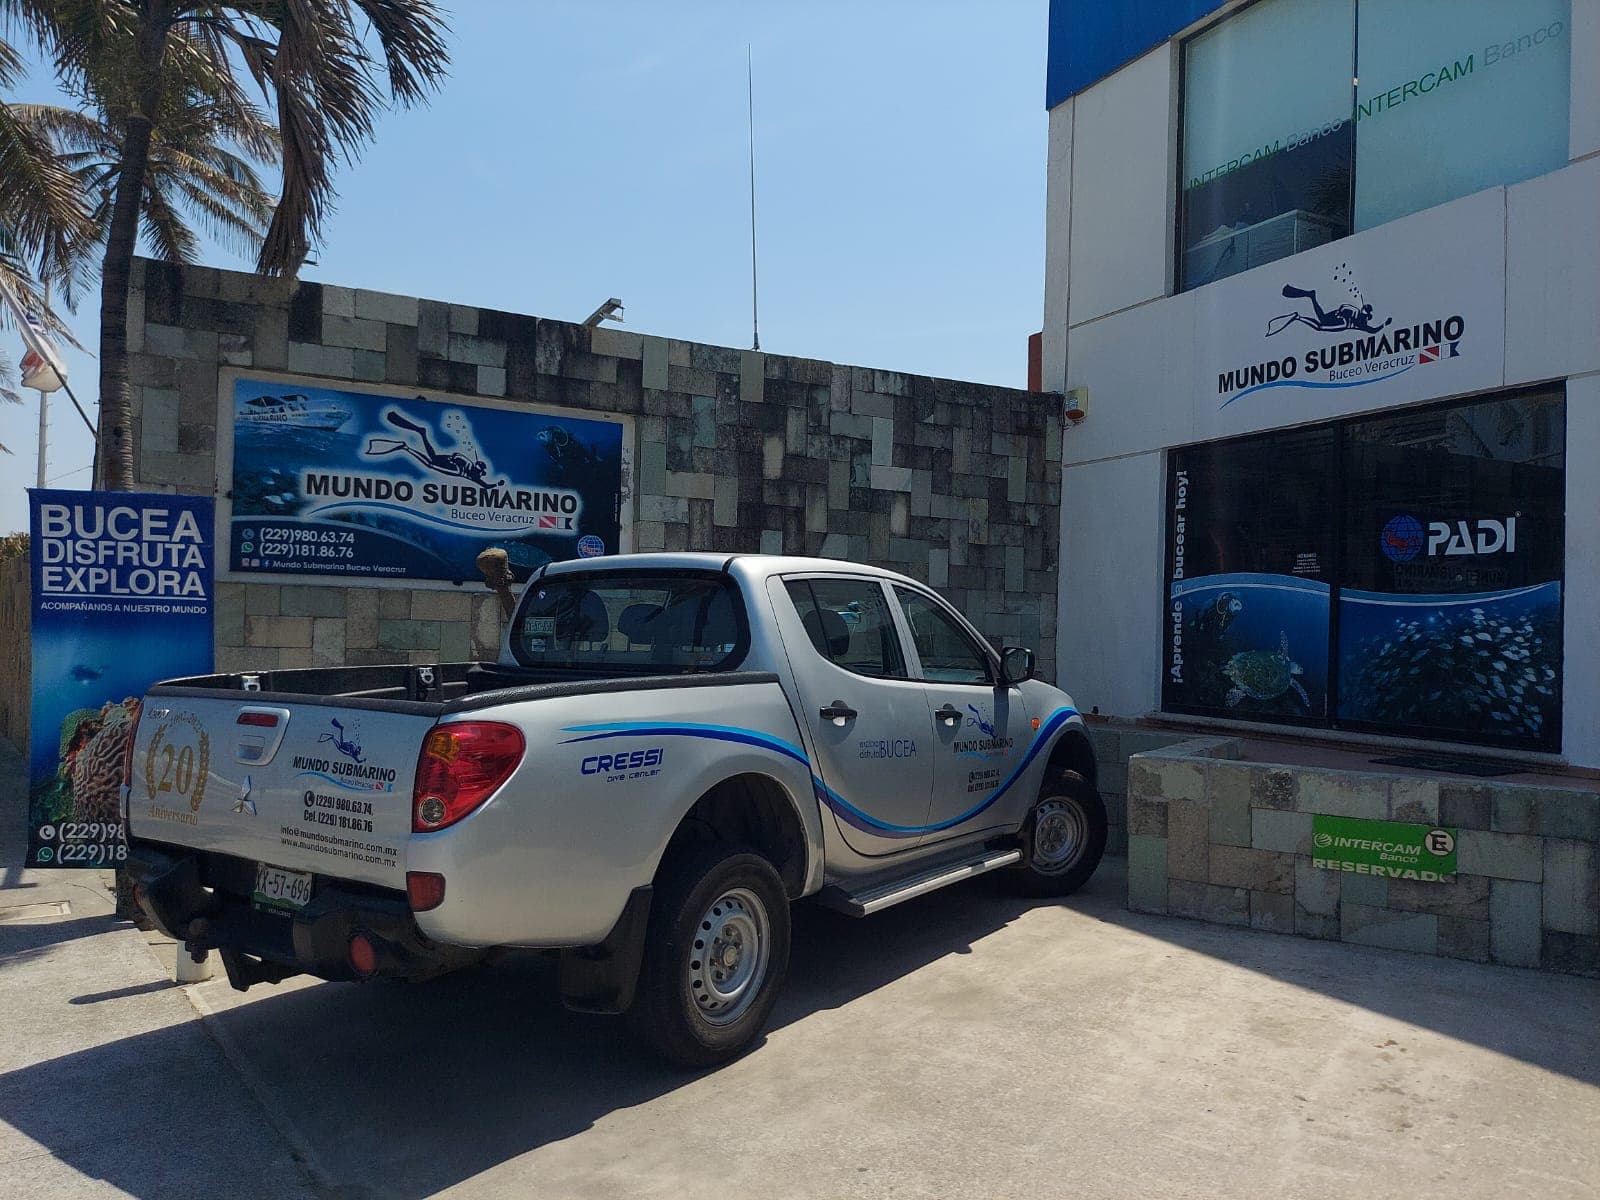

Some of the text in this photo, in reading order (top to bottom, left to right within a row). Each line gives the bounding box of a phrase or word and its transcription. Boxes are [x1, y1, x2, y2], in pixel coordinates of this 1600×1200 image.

[1483, 20, 1563, 66] Banco
[1189, 118, 1344, 188] INTERCAM Banco
[1218, 315, 1465, 394] MUNDO SUBMARINO
[1329, 353, 1415, 382] Buceo Veracruz
[305, 473, 414, 501] MUNDO
[423, 482, 578, 514] SUBMARINO
[40, 503, 204, 544] BUCEA
[451, 508, 535, 525] Buceo Veracruz
[259, 526, 355, 544] (229)980.63.74
[42, 538, 206, 569] DISFRUTA
[259, 541, 354, 559] (229)181.86.76
[42, 566, 206, 597] EXPLORA
[272, 560, 406, 574] Mundo Submarino Buceo Veracruz
[1170, 470, 1189, 684] ¡Aprende a bucear hoy!
[40, 601, 113, 612] ACOMPAÑANOS
[123, 604, 171, 613] NUESTRO
[172, 605, 207, 614] MUNDO
[880, 739, 917, 758] BUCEA
[953, 740, 978, 753] MUNDO
[157, 743, 194, 795] 20
[293, 756, 396, 782] MUNDO SUBMARINO
[581, 748, 664, 775] CRESSI
[280, 825, 398, 856] info@mundosubmarino.com.mx
[280, 838, 397, 868] www.mundosubmarino.com.mx
[1334, 836, 1422, 856] INTERCAM
[1379, 852, 1419, 864] Banco
